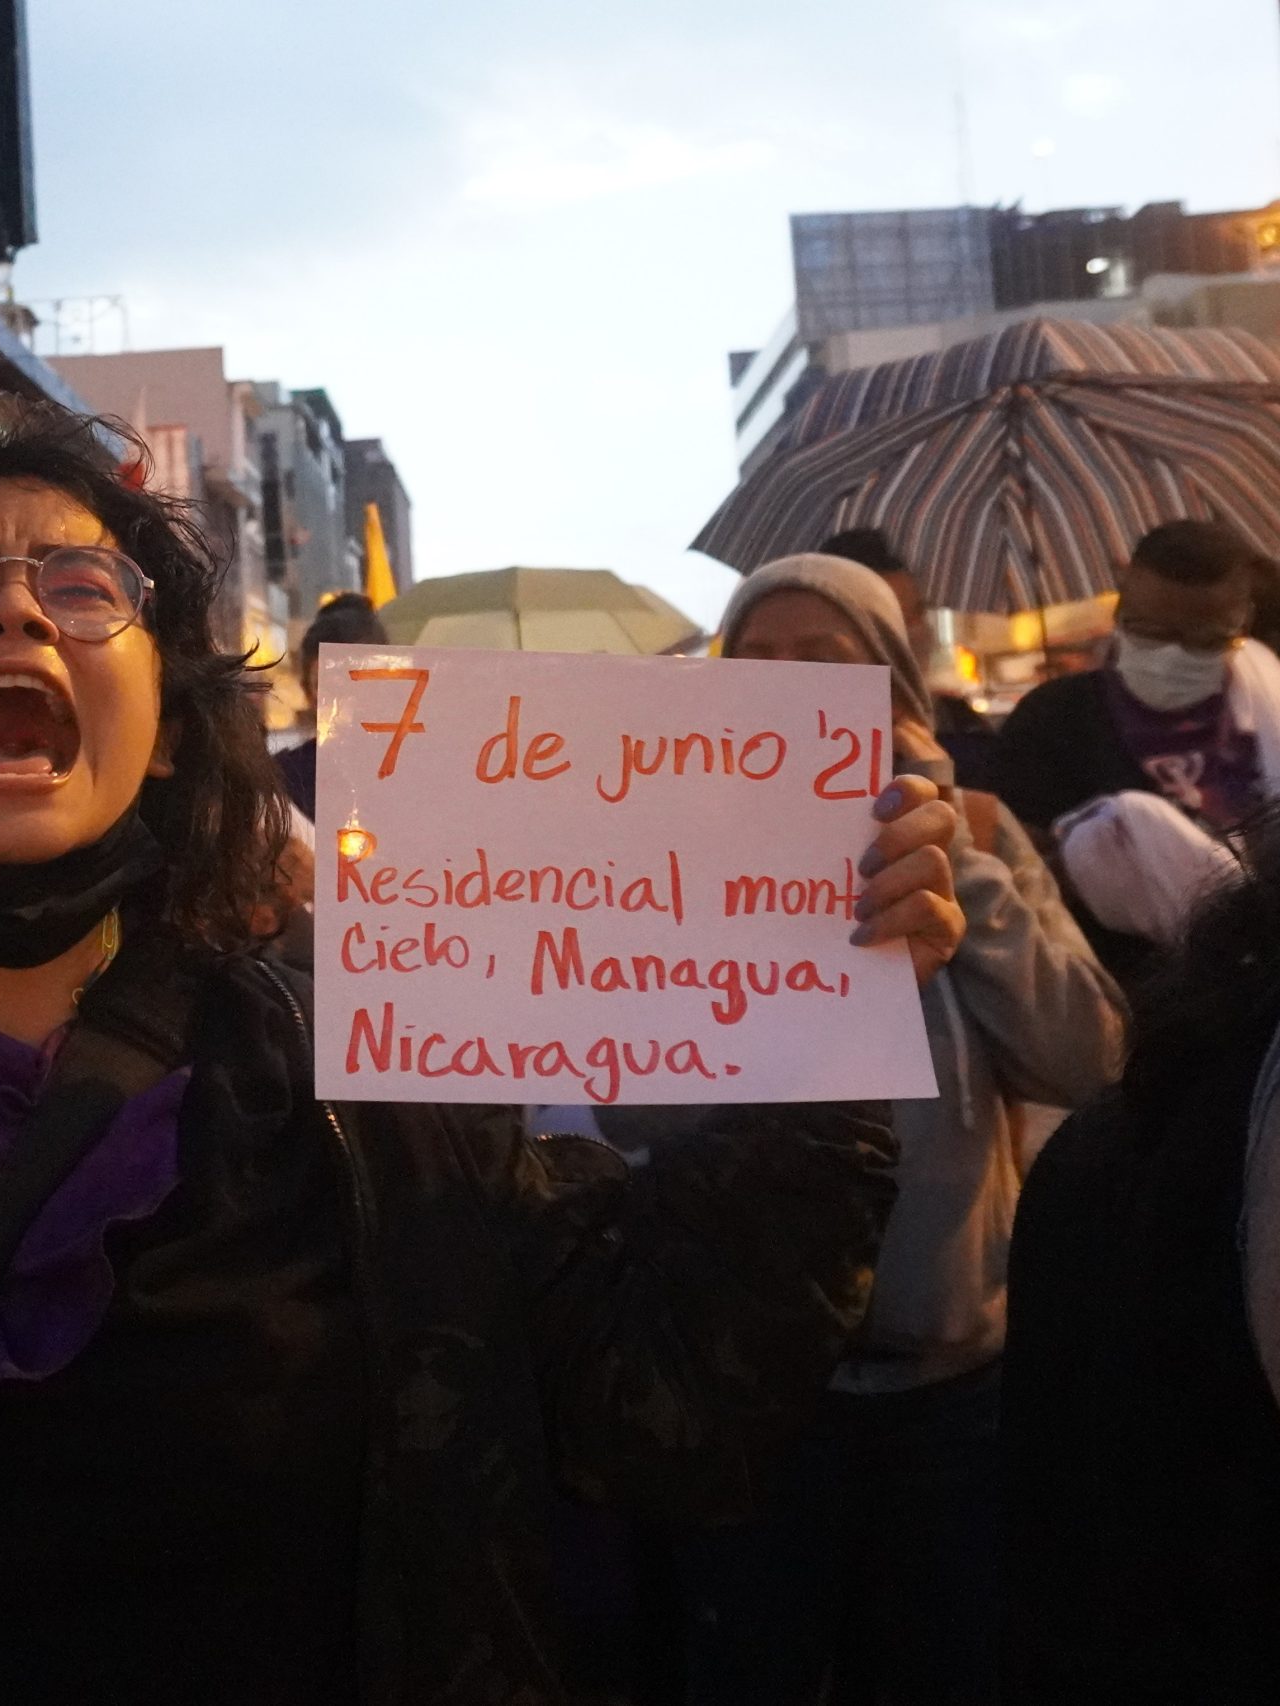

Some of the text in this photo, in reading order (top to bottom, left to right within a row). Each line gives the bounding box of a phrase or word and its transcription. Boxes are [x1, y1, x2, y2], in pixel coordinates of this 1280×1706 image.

[348, 668, 430, 780] 7
[475, 695, 572, 785] de
[595, 727, 788, 803] junio
[336, 828, 684, 926] Residencial
[531, 926, 851, 1026] Managua,
